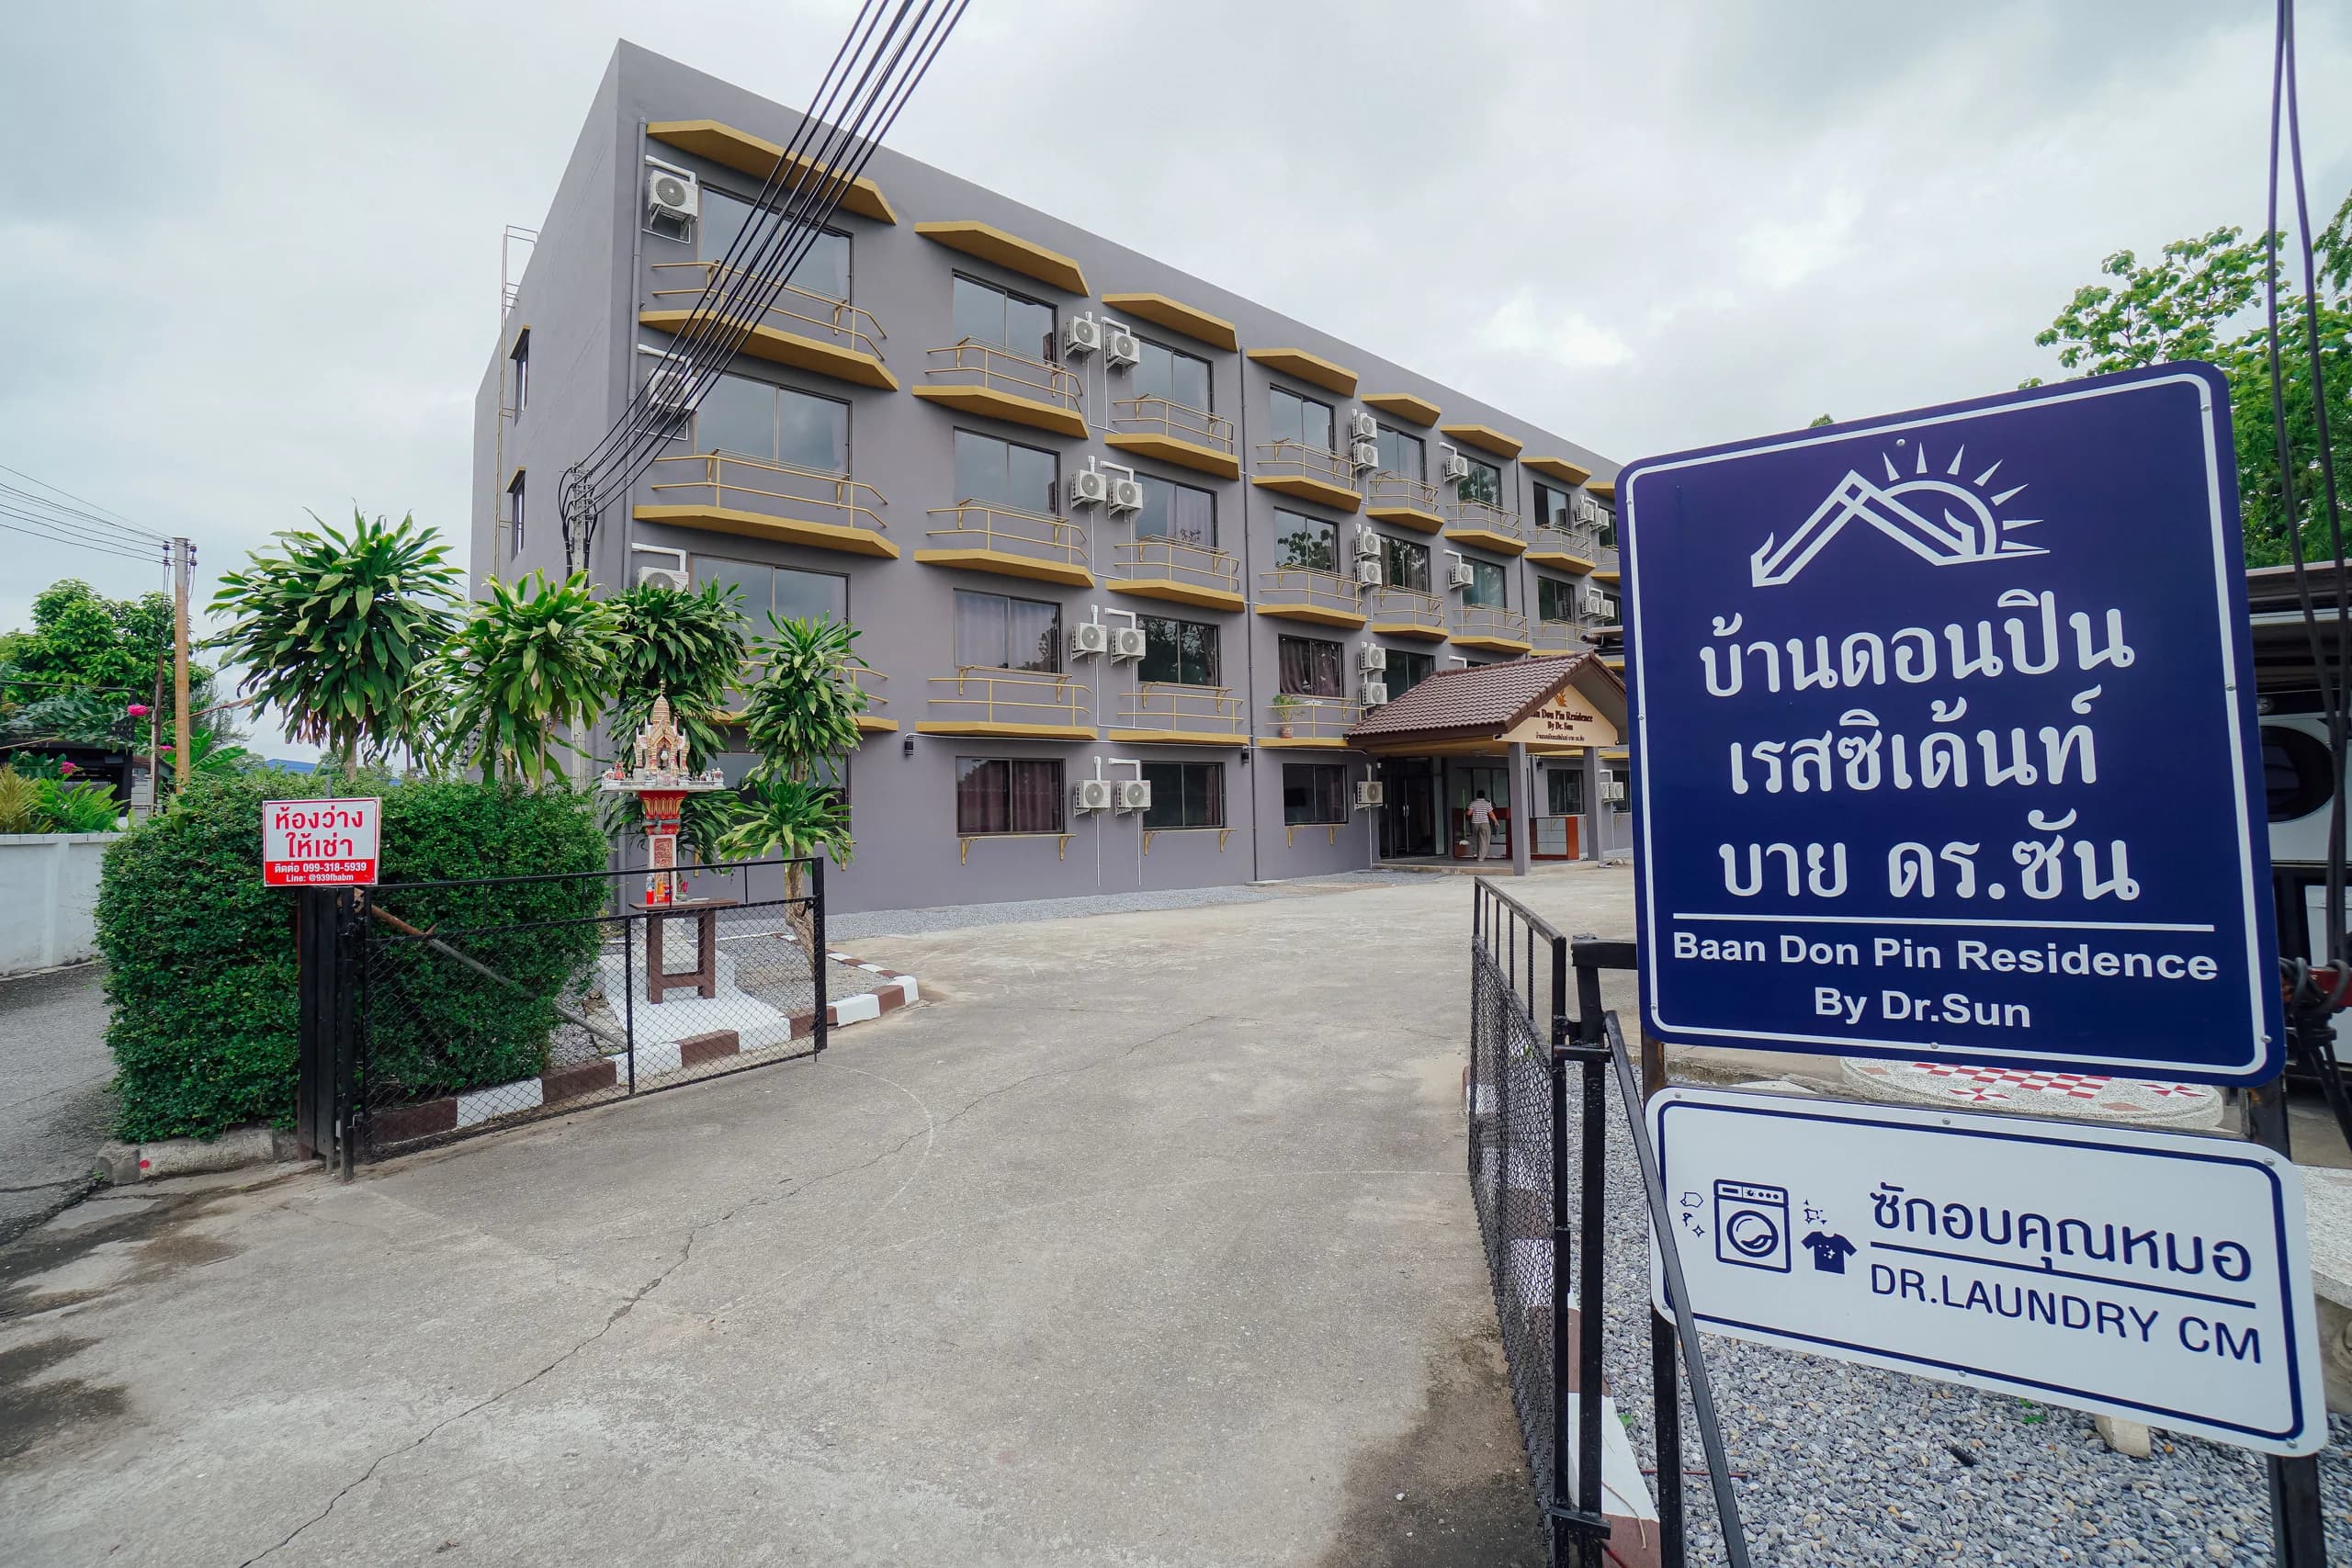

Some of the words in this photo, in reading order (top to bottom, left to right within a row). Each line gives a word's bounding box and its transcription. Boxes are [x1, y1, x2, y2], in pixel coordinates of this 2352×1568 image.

[1700, 588, 2135, 697] บ้านดอนปิน
[1566, 711, 1593, 722] Residence
[1730, 683, 2102, 795] เรสซิเด้นท์
[275, 805, 364, 829] ห้องว่าง
[285, 831, 354, 858] ให้เช่า
[1718, 842, 1848, 897] บาย
[1887, 807, 2141, 901] ดร.ซัน
[275, 863, 300, 874] ติดต่อ
[302, 862, 368, 873] 099-318-5939
[286, 874, 307, 883] Line:
[308, 873, 354, 882] @939fbabm
[1674, 931, 1766, 962] Baan
[1780, 934, 1860, 965] Don
[1873, 937, 1941, 969] Pin
[1957, 940, 2219, 981] Residence
[1815, 987, 1868, 1025] By
[1882, 989, 2030, 1028] Dr.Sun
[1870, 1181, 2252, 1282] ซักอบคุณหมอ
[1871, 1263, 2159, 1343] DR.LAUNDRY
[2178, 1315, 2262, 1364] CM
